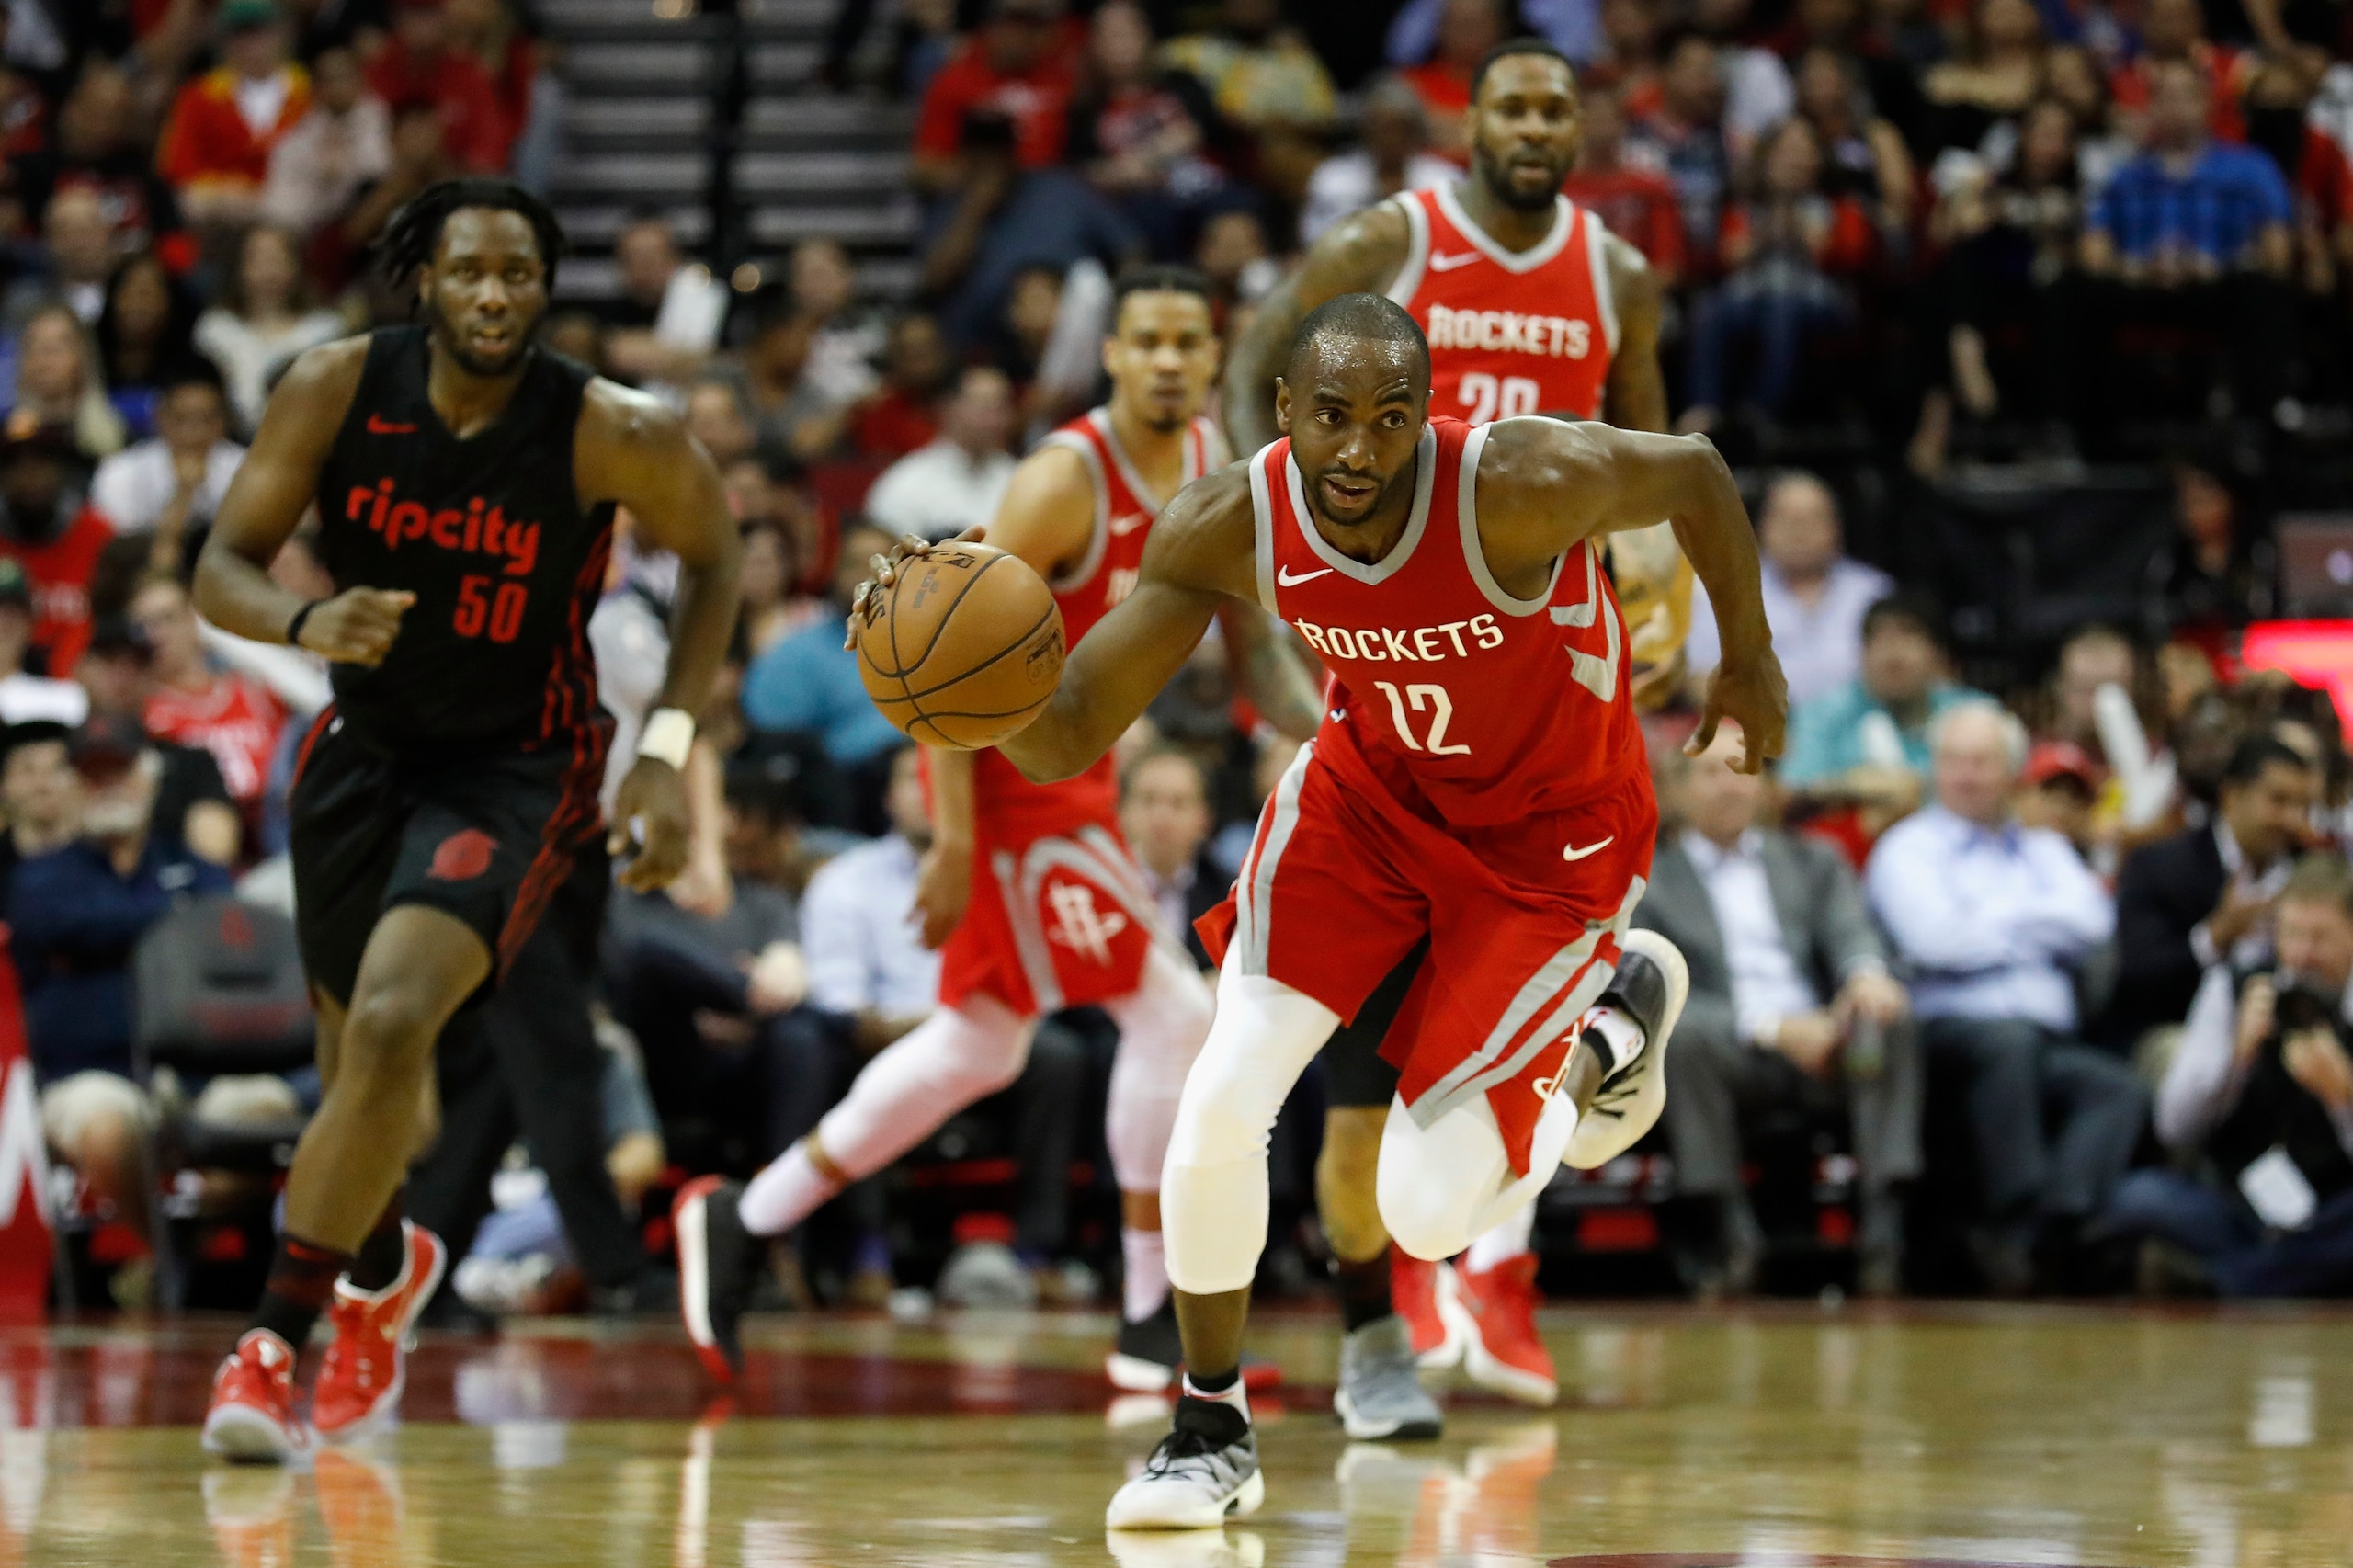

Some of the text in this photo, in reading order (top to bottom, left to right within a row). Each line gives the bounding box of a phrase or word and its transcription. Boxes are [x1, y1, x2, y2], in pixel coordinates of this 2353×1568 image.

[1427, 301, 1591, 361] ROCKETS
[346, 476, 540, 576] ripcity
[453, 574, 529, 642] 50
[1293, 613, 1505, 662] ROCKETS
[1374, 680, 1472, 756] 12
